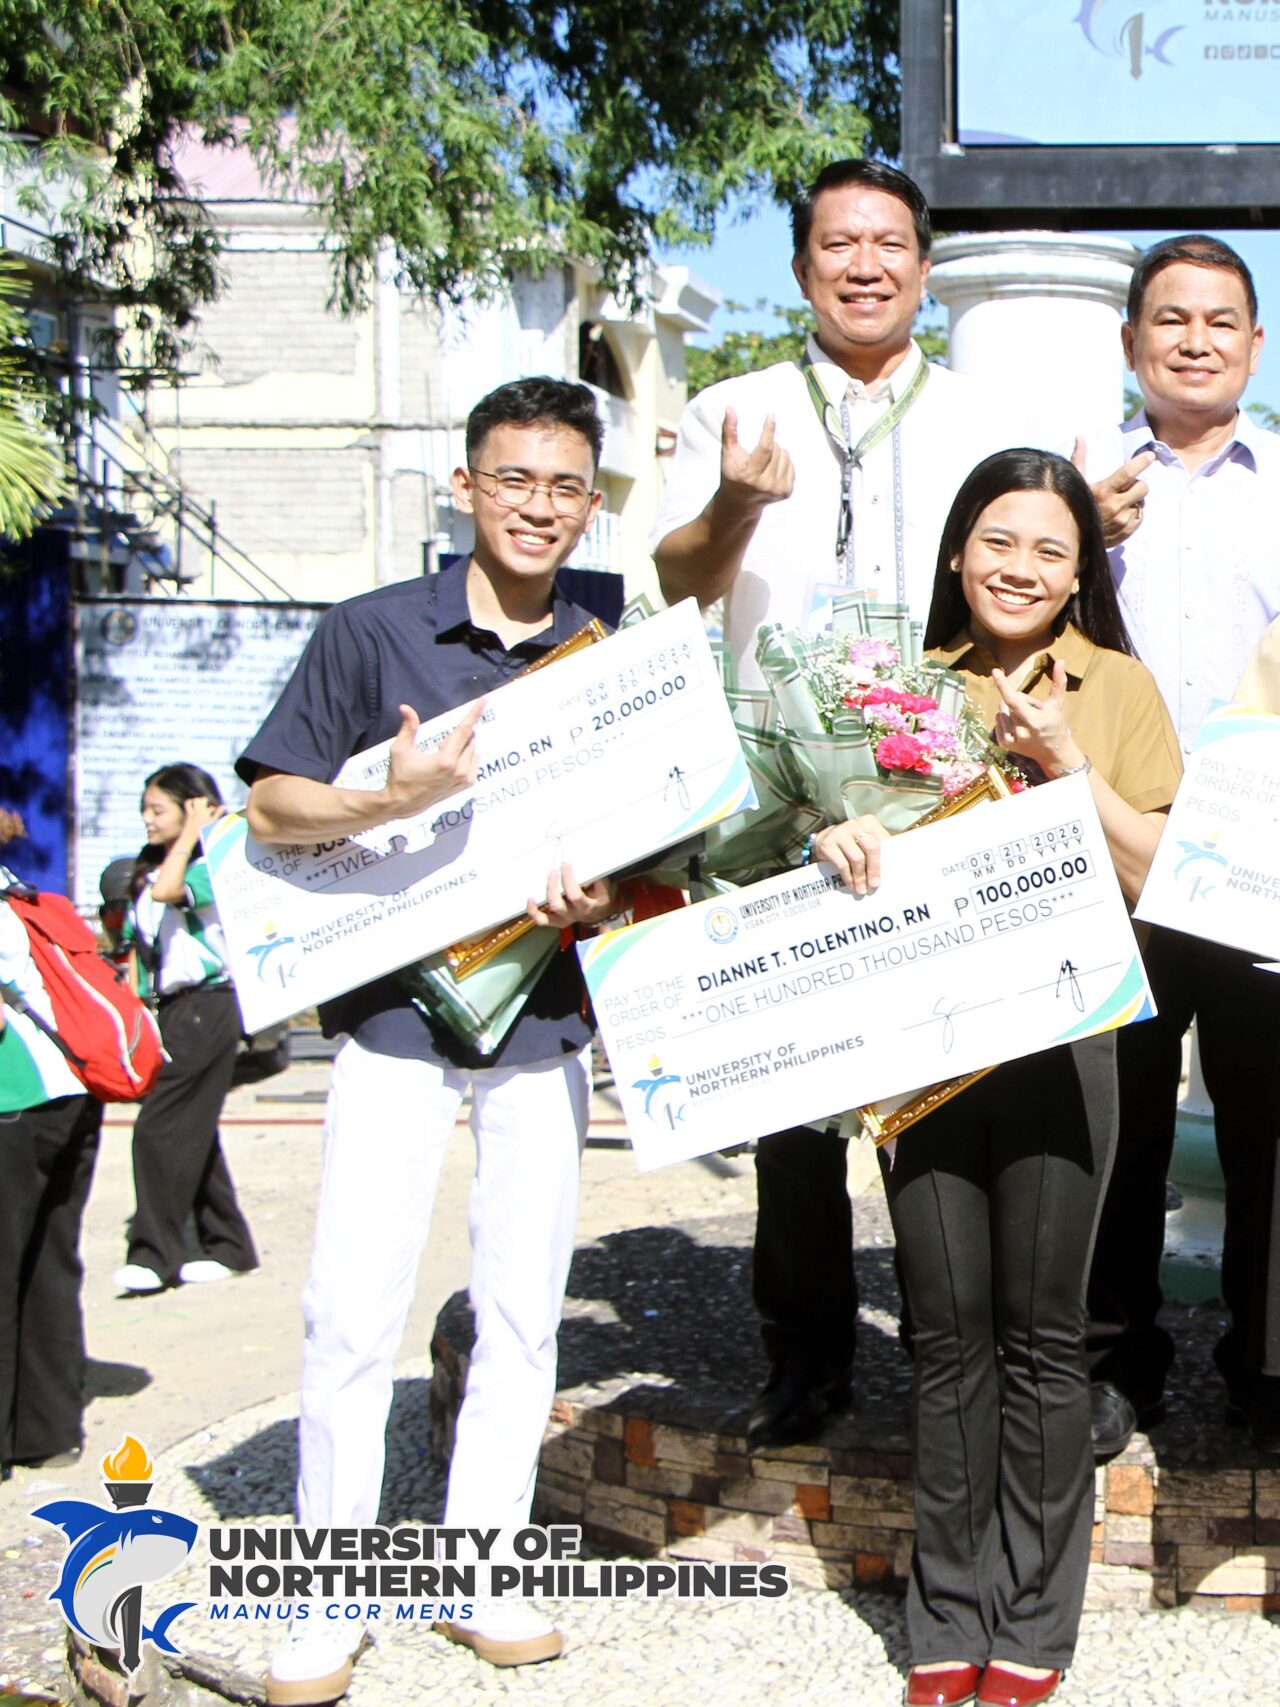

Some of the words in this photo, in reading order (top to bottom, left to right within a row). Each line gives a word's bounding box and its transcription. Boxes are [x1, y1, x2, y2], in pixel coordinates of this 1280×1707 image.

[528, 735, 553, 758] RN
[1200, 757, 1227, 777] PAY
[1234, 767, 1256, 783] TO
[1195, 773, 1254, 799] ORDER
[1256, 790, 1280, 805] OF
[418, 776, 531, 839] THOUSAND
[1186, 795, 1242, 822] PESOS
[253, 855, 274, 873] TO
[275, 843, 306, 863] THE
[282, 859, 303, 877] OF
[942, 861, 968, 877] DATE
[299, 897, 386, 944] UNIVERSITY
[391, 888, 412, 903] OF
[302, 911, 384, 956] NORTHERN
[387, 869, 479, 917] PHILIPPINES
[739, 893, 781, 920] UNIVERSITY
[782, 891, 791, 906] OF
[792, 876, 833, 902] NORTHERN
[697, 956, 769, 992] DIANNE
[770, 950, 788, 969] T.
[788, 915, 901, 963] TOLENTINO,
[902, 902, 931, 927] RN
[975, 856, 1088, 906] 100,000.00
[753, 961, 856, 1009] HUNDRED
[858, 923, 975, 974] THOUSAND
[604, 993, 630, 1012] PAY
[633, 986, 654, 1001] TO
[656, 975, 687, 994] THE
[608, 1000, 662, 1027] ORDER
[664, 992, 685, 1010] OF
[615, 1026, 667, 1054] PESOS
[685, 1049, 773, 1086] UNIVERSITY
[777, 1042, 797, 1057] OF
[688, 1064, 770, 1098] NORTHERN
[773, 1034, 865, 1072] PHILIPPINES
